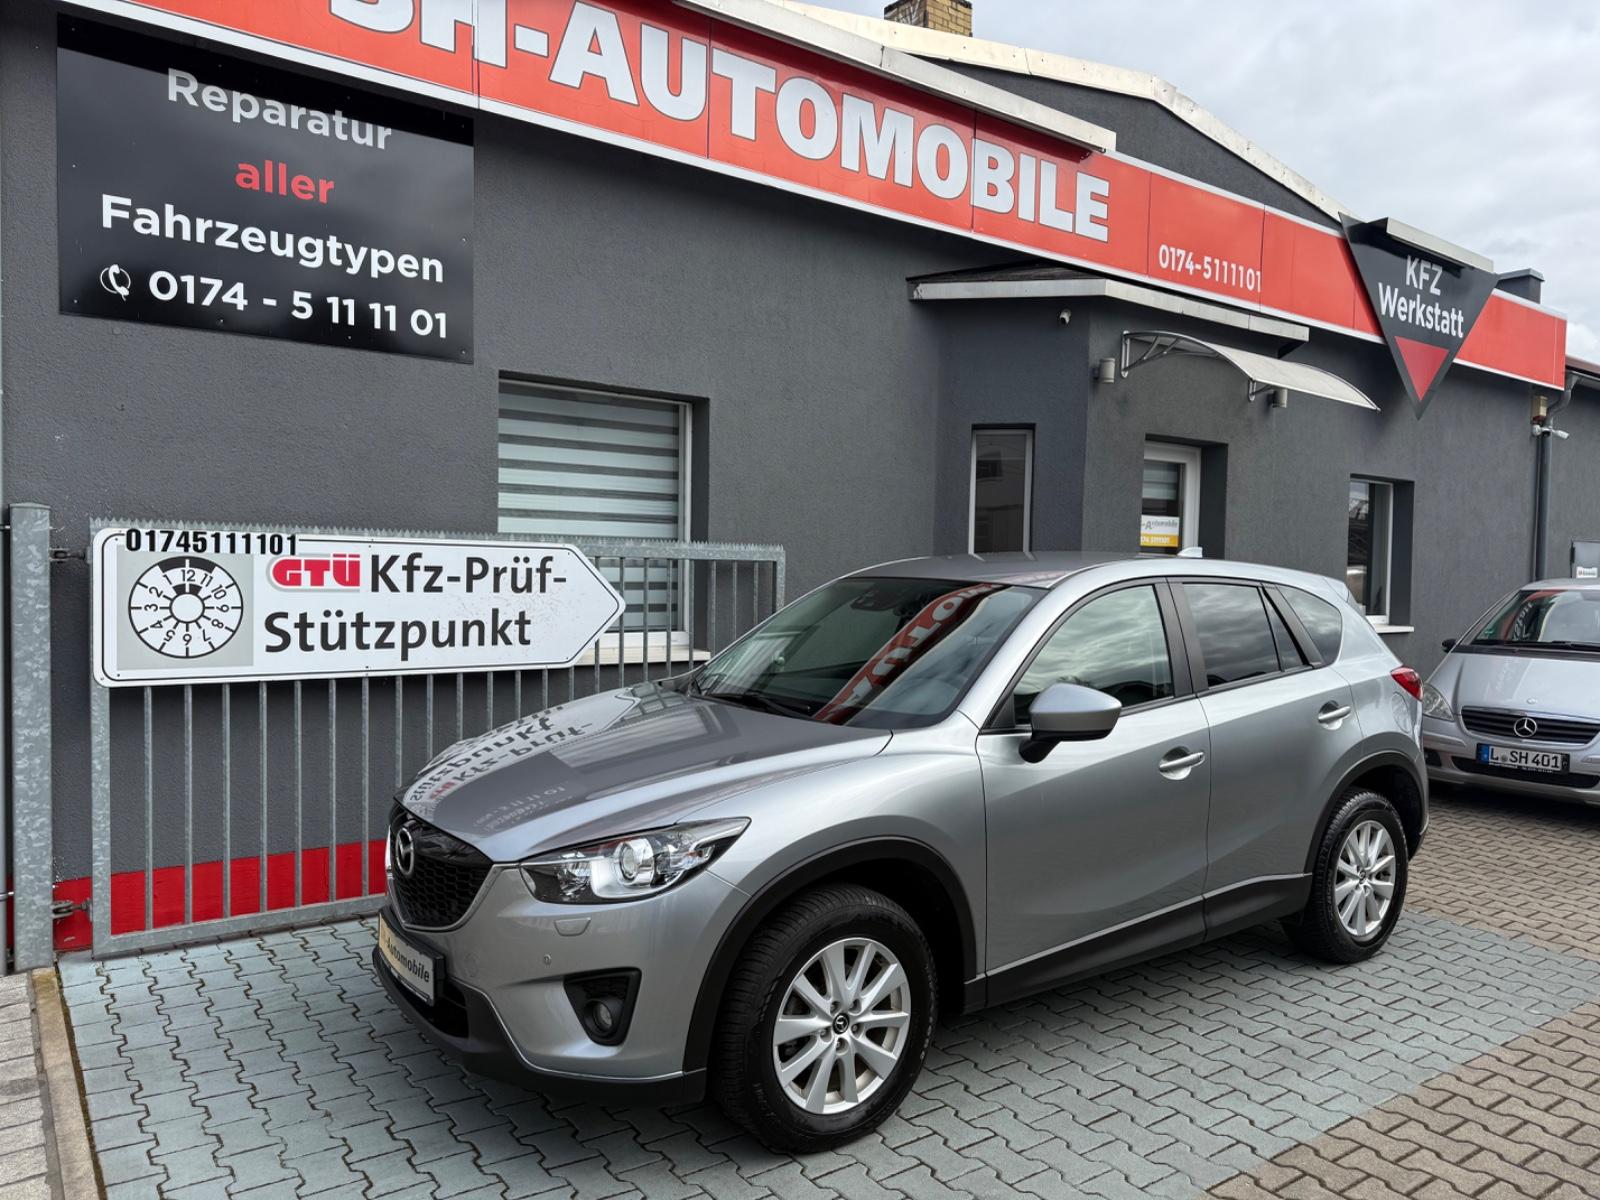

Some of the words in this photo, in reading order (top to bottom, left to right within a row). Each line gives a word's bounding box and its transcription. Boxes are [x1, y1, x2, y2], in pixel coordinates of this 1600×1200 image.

[167, 68, 392, 151] Reparatur
[235, 160, 335, 204] aller
[102, 194, 444, 283] Fahrzeugtypen
[1159, 244, 1261, 294] 0174-5111101
[1406, 254, 1443, 296] KFZ
[149, 270, 248, 311] 0174
[291, 291, 313, 319] 5
[327, 296, 355, 326] 11
[369, 302, 397, 332] 11
[410, 309, 447, 338] 01
[1378, 282, 1464, 338] Werkstatt
[126, 528, 297, 556] 01745111101
[163, 574, 173, 585] 1
[181, 569, 196, 582] 12
[200, 573, 214, 588] 11
[272, 553, 361, 588] GTÜ
[371, 552, 567, 594] Kfz-Prüf-
[148, 586, 164, 598] 2
[211, 584, 227, 600] 10
[144, 603, 159, 612] 3
[216, 604, 230, 613] 9
[150, 619, 164, 630] 4
[211, 619, 224, 629] 8
[164, 629, 176, 642] 5
[183, 633, 192, 645] 6
[202, 629, 211, 642] 7
[264, 608, 532, 661] Stützpunkt
[1490, 747, 1499, 761] L
[1509, 750, 1529, 765] SH
[1531, 753, 1560, 769] 401
